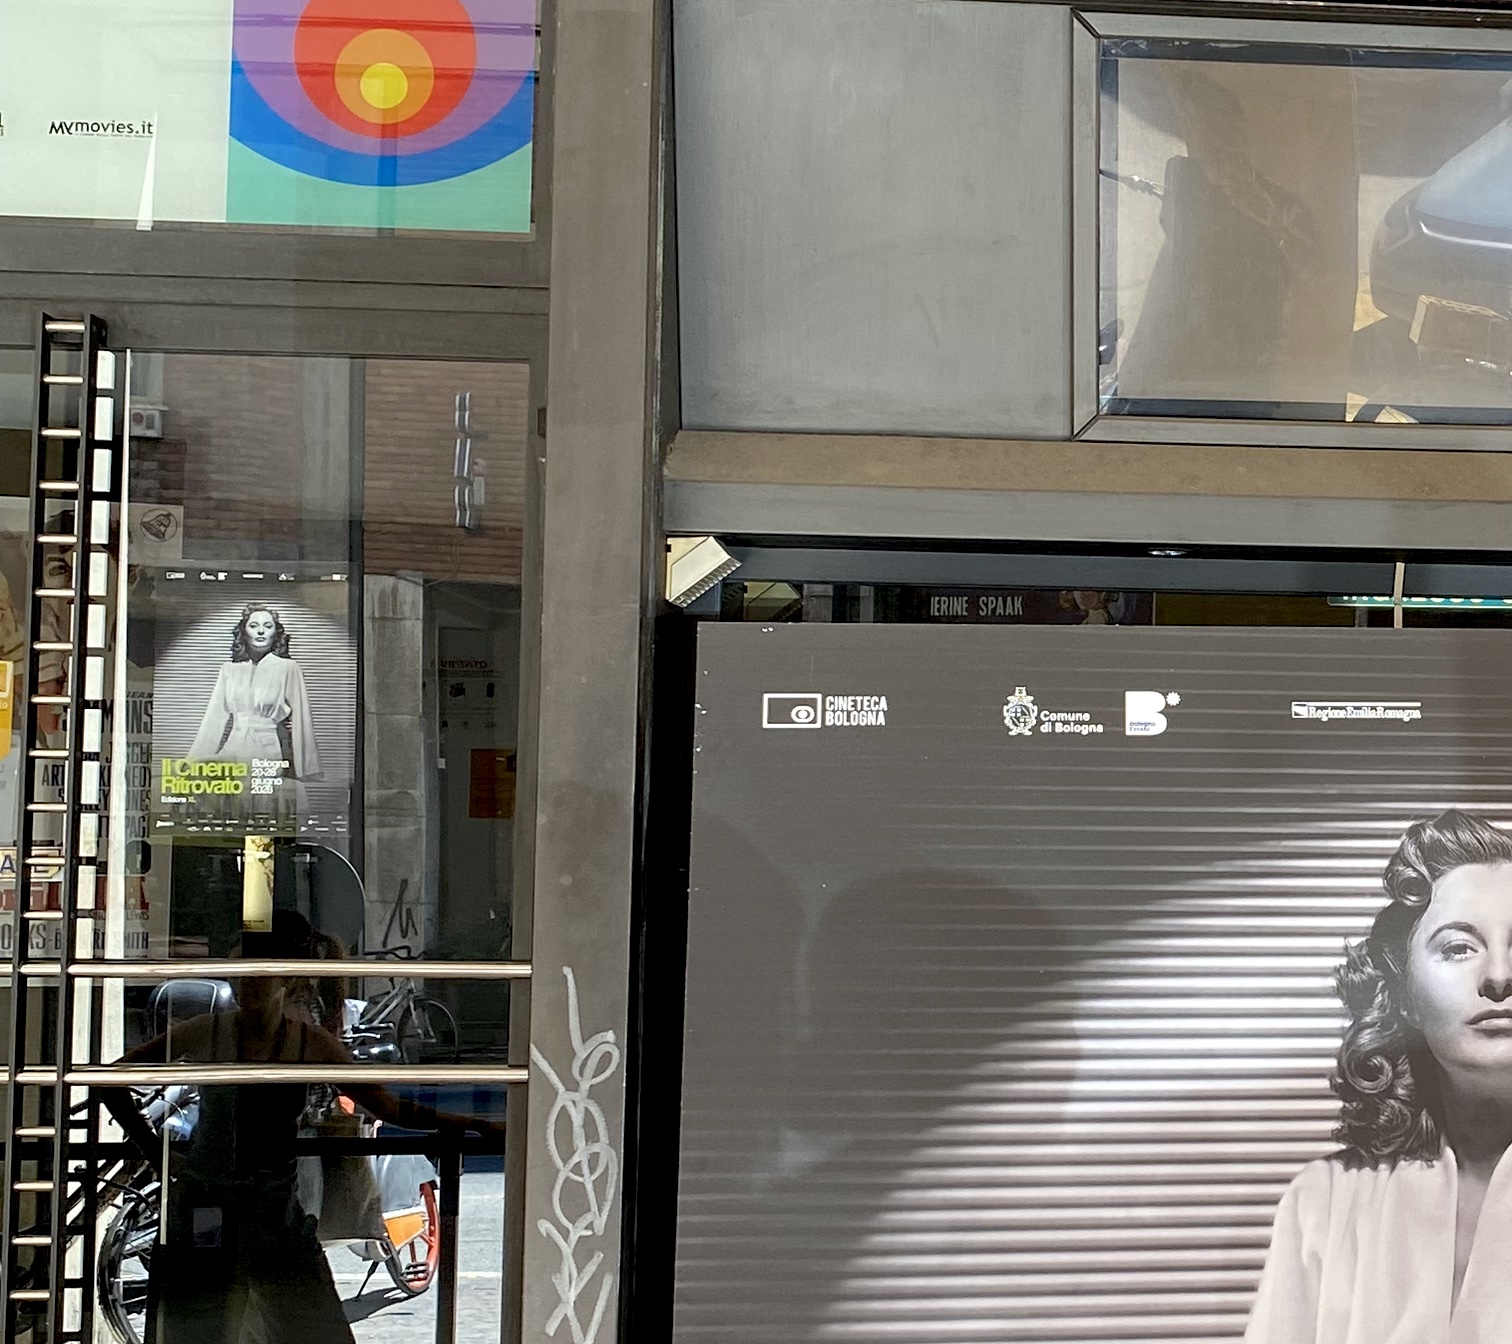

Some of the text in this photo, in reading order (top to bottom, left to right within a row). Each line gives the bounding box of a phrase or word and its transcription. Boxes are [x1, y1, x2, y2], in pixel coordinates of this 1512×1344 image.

[978, 596, 1023, 616] SPAAK
[825, 695, 888, 711] CINETECA
[825, 710, 886, 726] BOLOGNA
[1040, 710, 1091, 722] Comune
[1040, 722, 1104, 735] di Bologna
[174, 759, 248, 777] Cinema
[161, 776, 243, 795] Ritrovato
